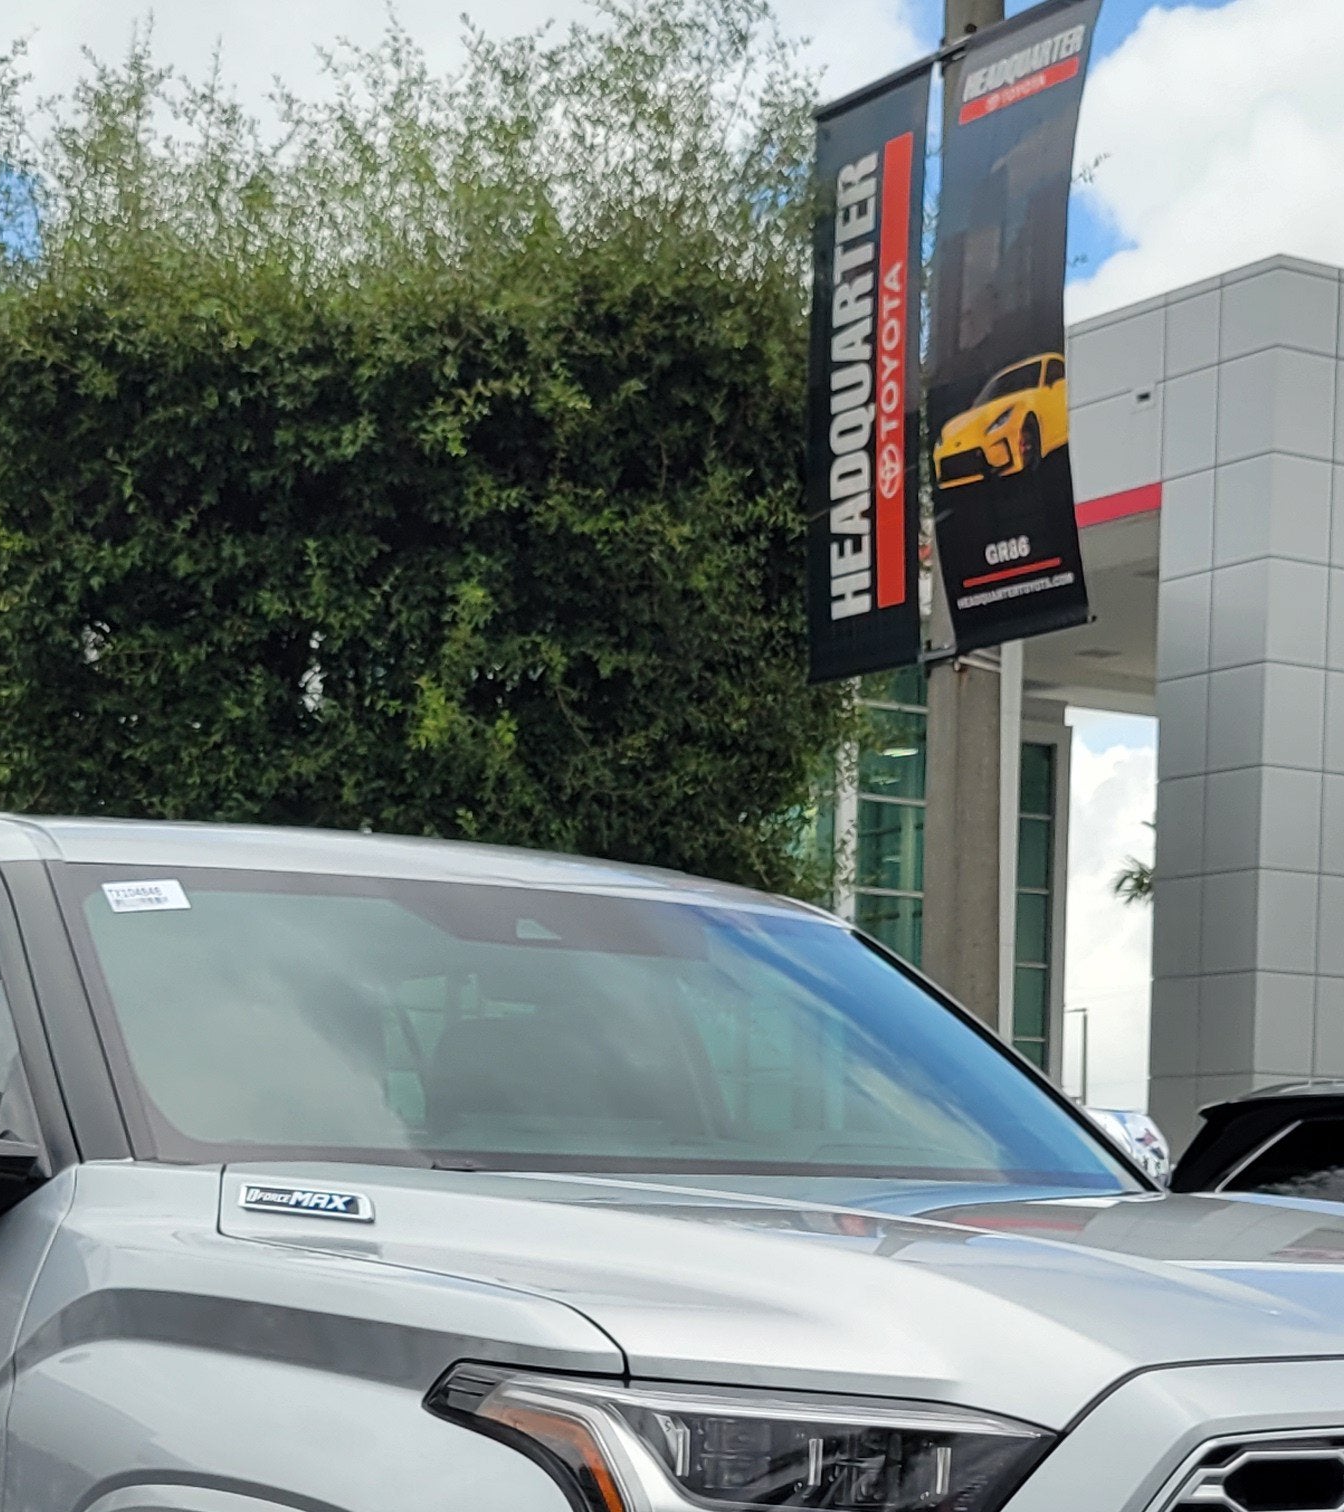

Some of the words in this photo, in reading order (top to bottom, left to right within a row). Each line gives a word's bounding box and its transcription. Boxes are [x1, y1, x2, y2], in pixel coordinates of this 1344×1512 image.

[829, 150, 878, 622] HEADQUARTER
[878, 260, 904, 436] TOYOTA
[984, 534, 1031, 566] GR86
[289, 1191, 353, 1212] MAX
